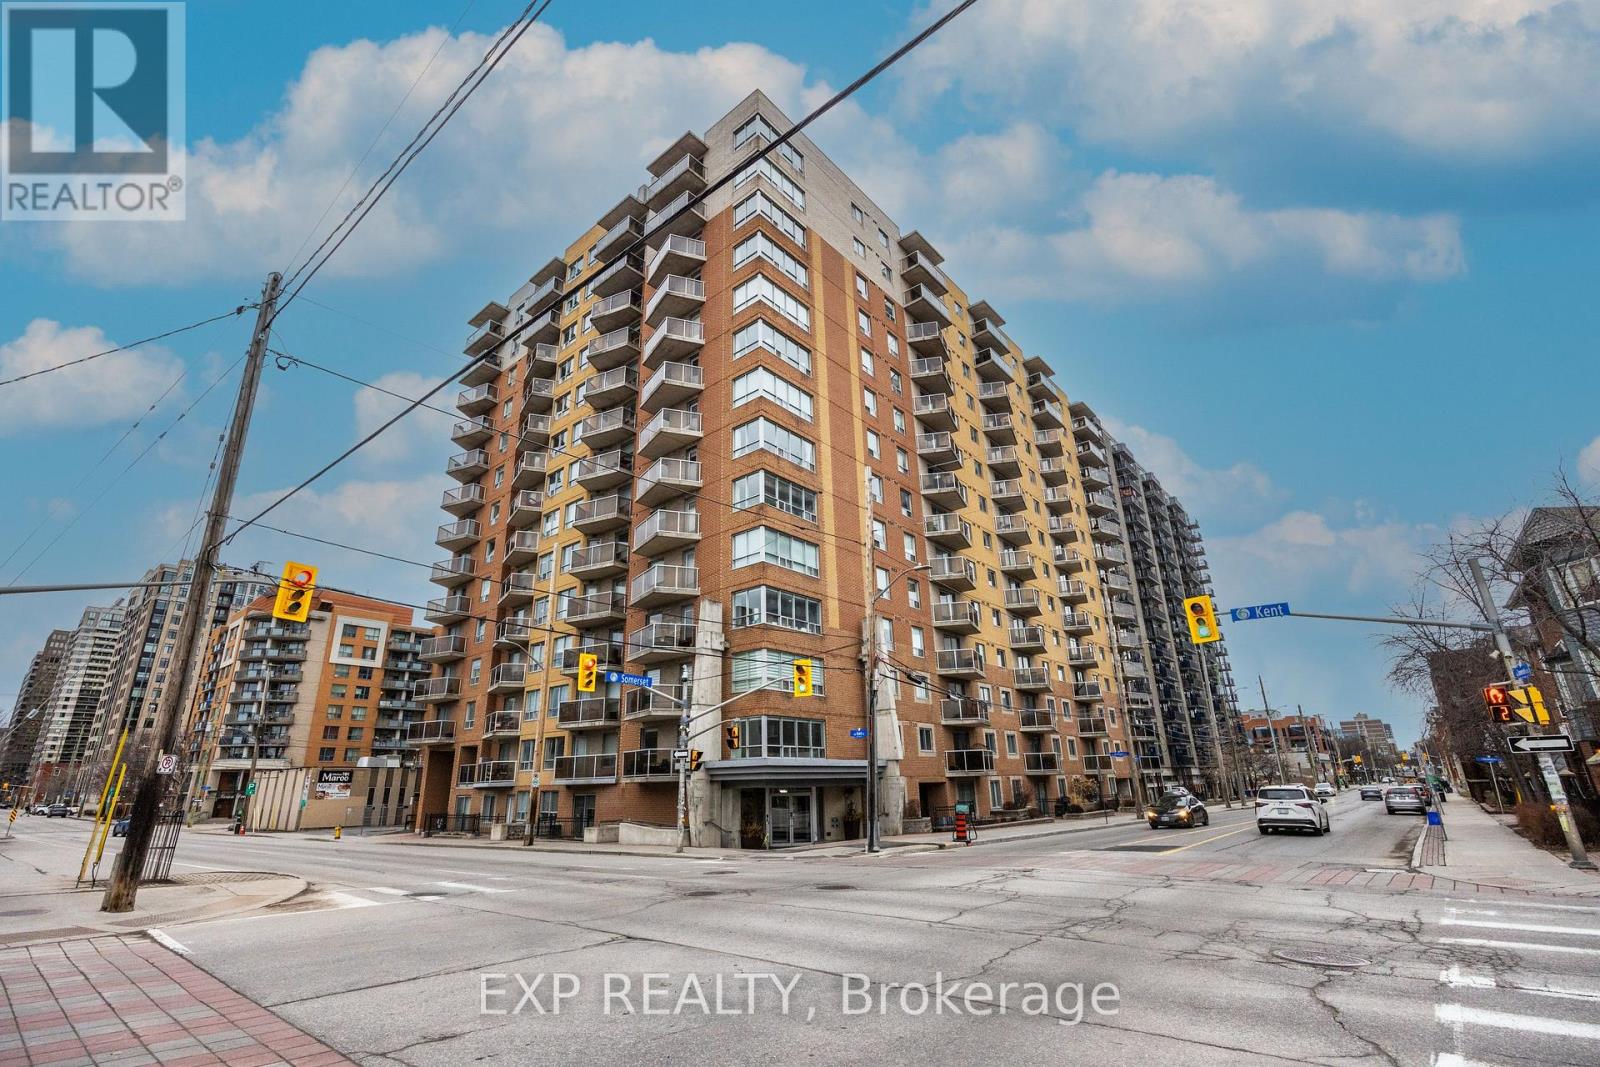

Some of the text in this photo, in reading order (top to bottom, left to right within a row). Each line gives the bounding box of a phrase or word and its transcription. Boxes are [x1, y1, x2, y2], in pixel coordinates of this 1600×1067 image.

[1255, 605, 1284, 618] Kent
[620, 674, 649, 687] Somerset
[1500, 706, 1510, 721] 2
